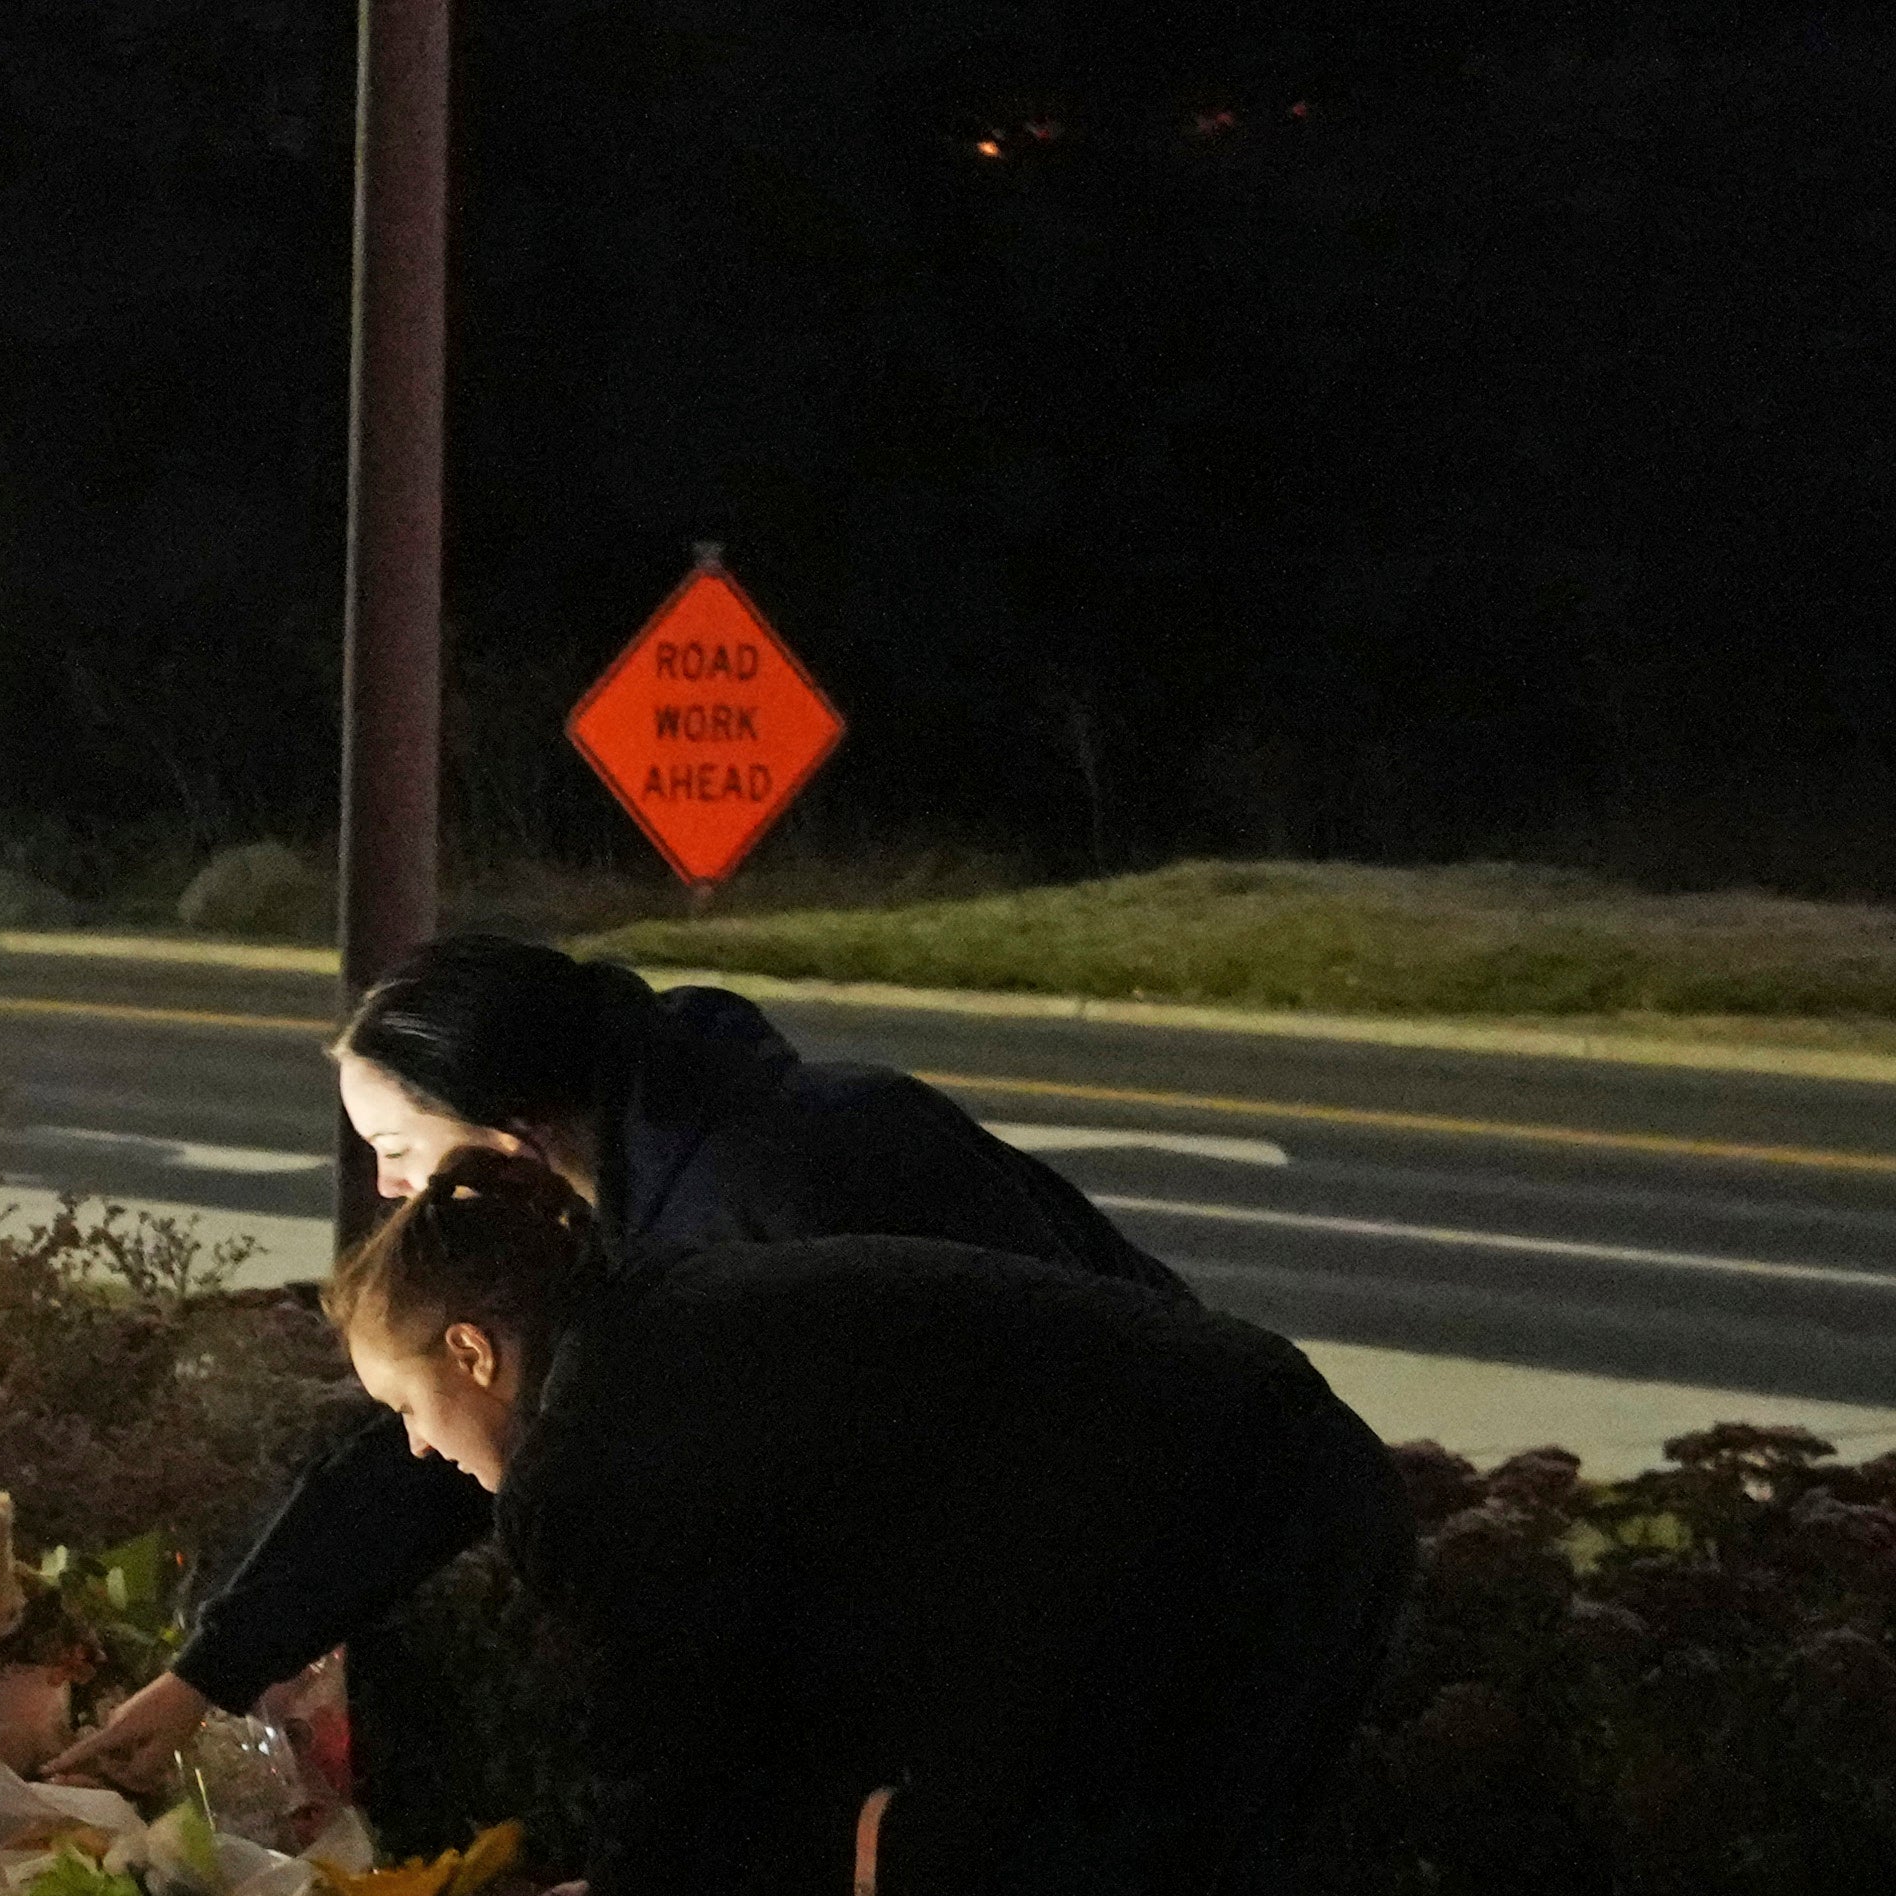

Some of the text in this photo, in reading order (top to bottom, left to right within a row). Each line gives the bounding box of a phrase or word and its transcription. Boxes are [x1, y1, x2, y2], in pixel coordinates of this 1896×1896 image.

[656, 643, 758, 681] ROAD
[655, 704, 759, 743] WORK
[641, 763, 773, 803] AHEAD
